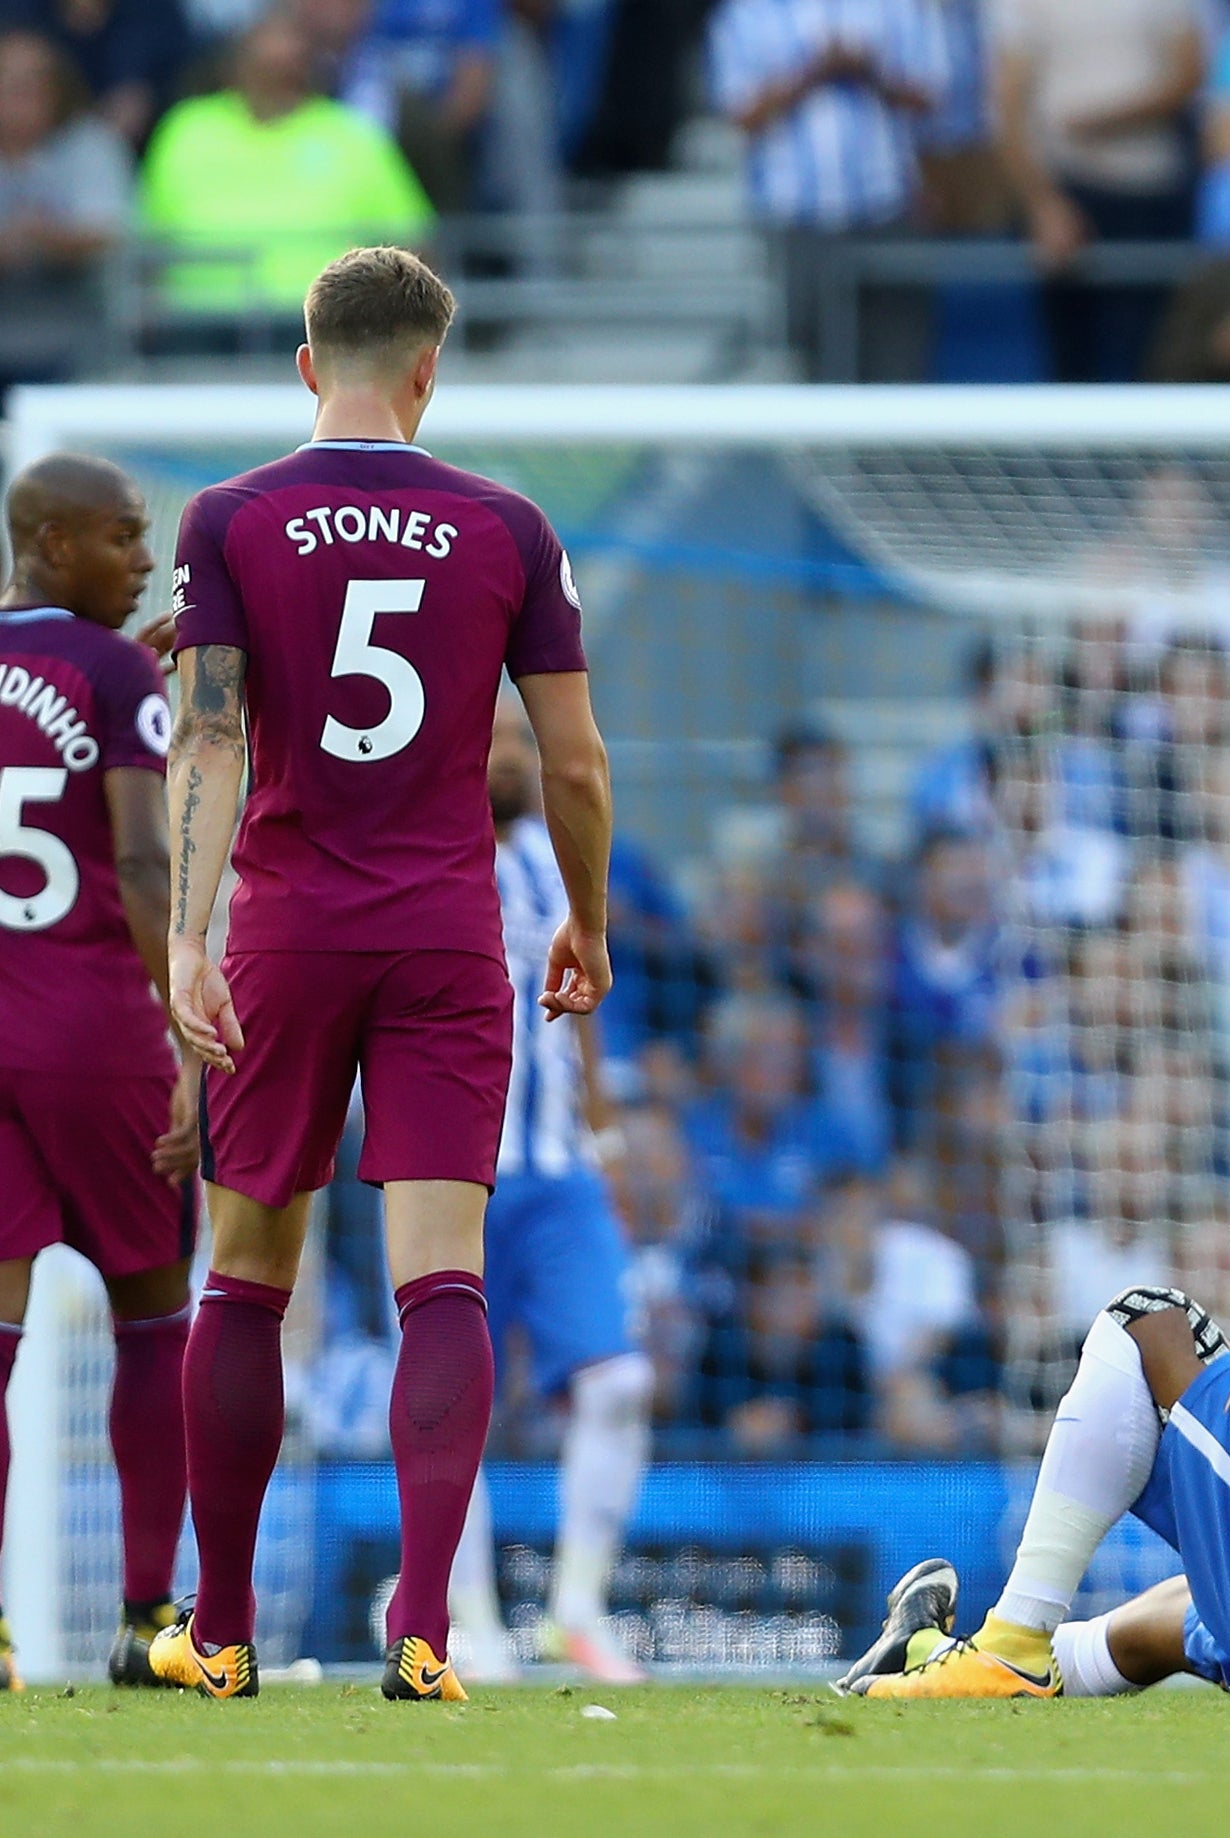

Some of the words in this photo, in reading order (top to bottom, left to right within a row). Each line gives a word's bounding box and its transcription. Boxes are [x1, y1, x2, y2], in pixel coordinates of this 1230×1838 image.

[285, 506, 458, 559] STONES
[0, 663, 99, 771] DINHO
[320, 578, 426, 762] 5
[0, 766, 80, 931] 5
